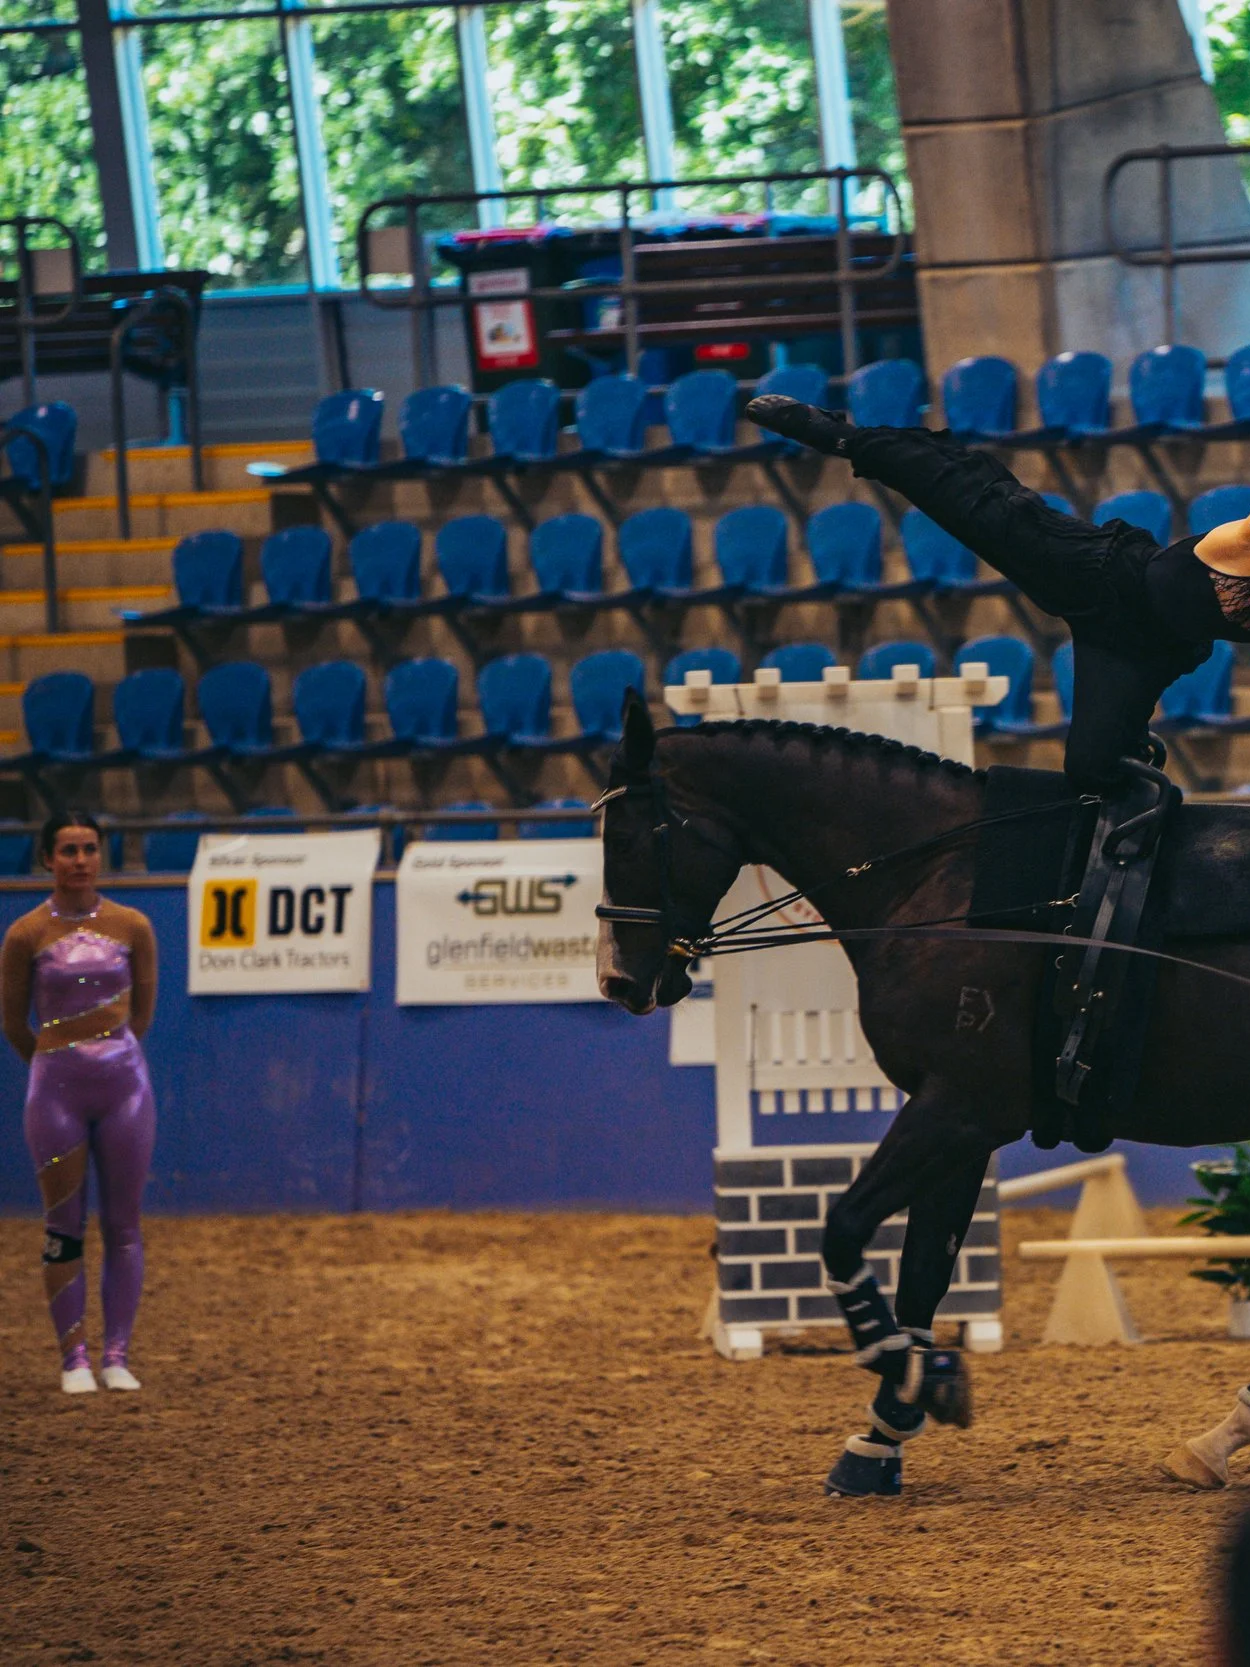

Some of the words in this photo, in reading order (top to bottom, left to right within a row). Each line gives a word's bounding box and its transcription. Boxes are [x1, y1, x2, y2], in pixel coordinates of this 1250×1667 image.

[252, 854, 305, 867] Sponsor
[412, 856, 445, 868] Gold
[450, 856, 504, 868] Sponsor
[474, 879, 562, 915] GWS
[268, 886, 353, 936] DCT
[200, 953, 235, 969] Don
[240, 951, 281, 969] Clark
[286, 950, 349, 969] Tractors
[464, 972, 568, 987] SERVICES
